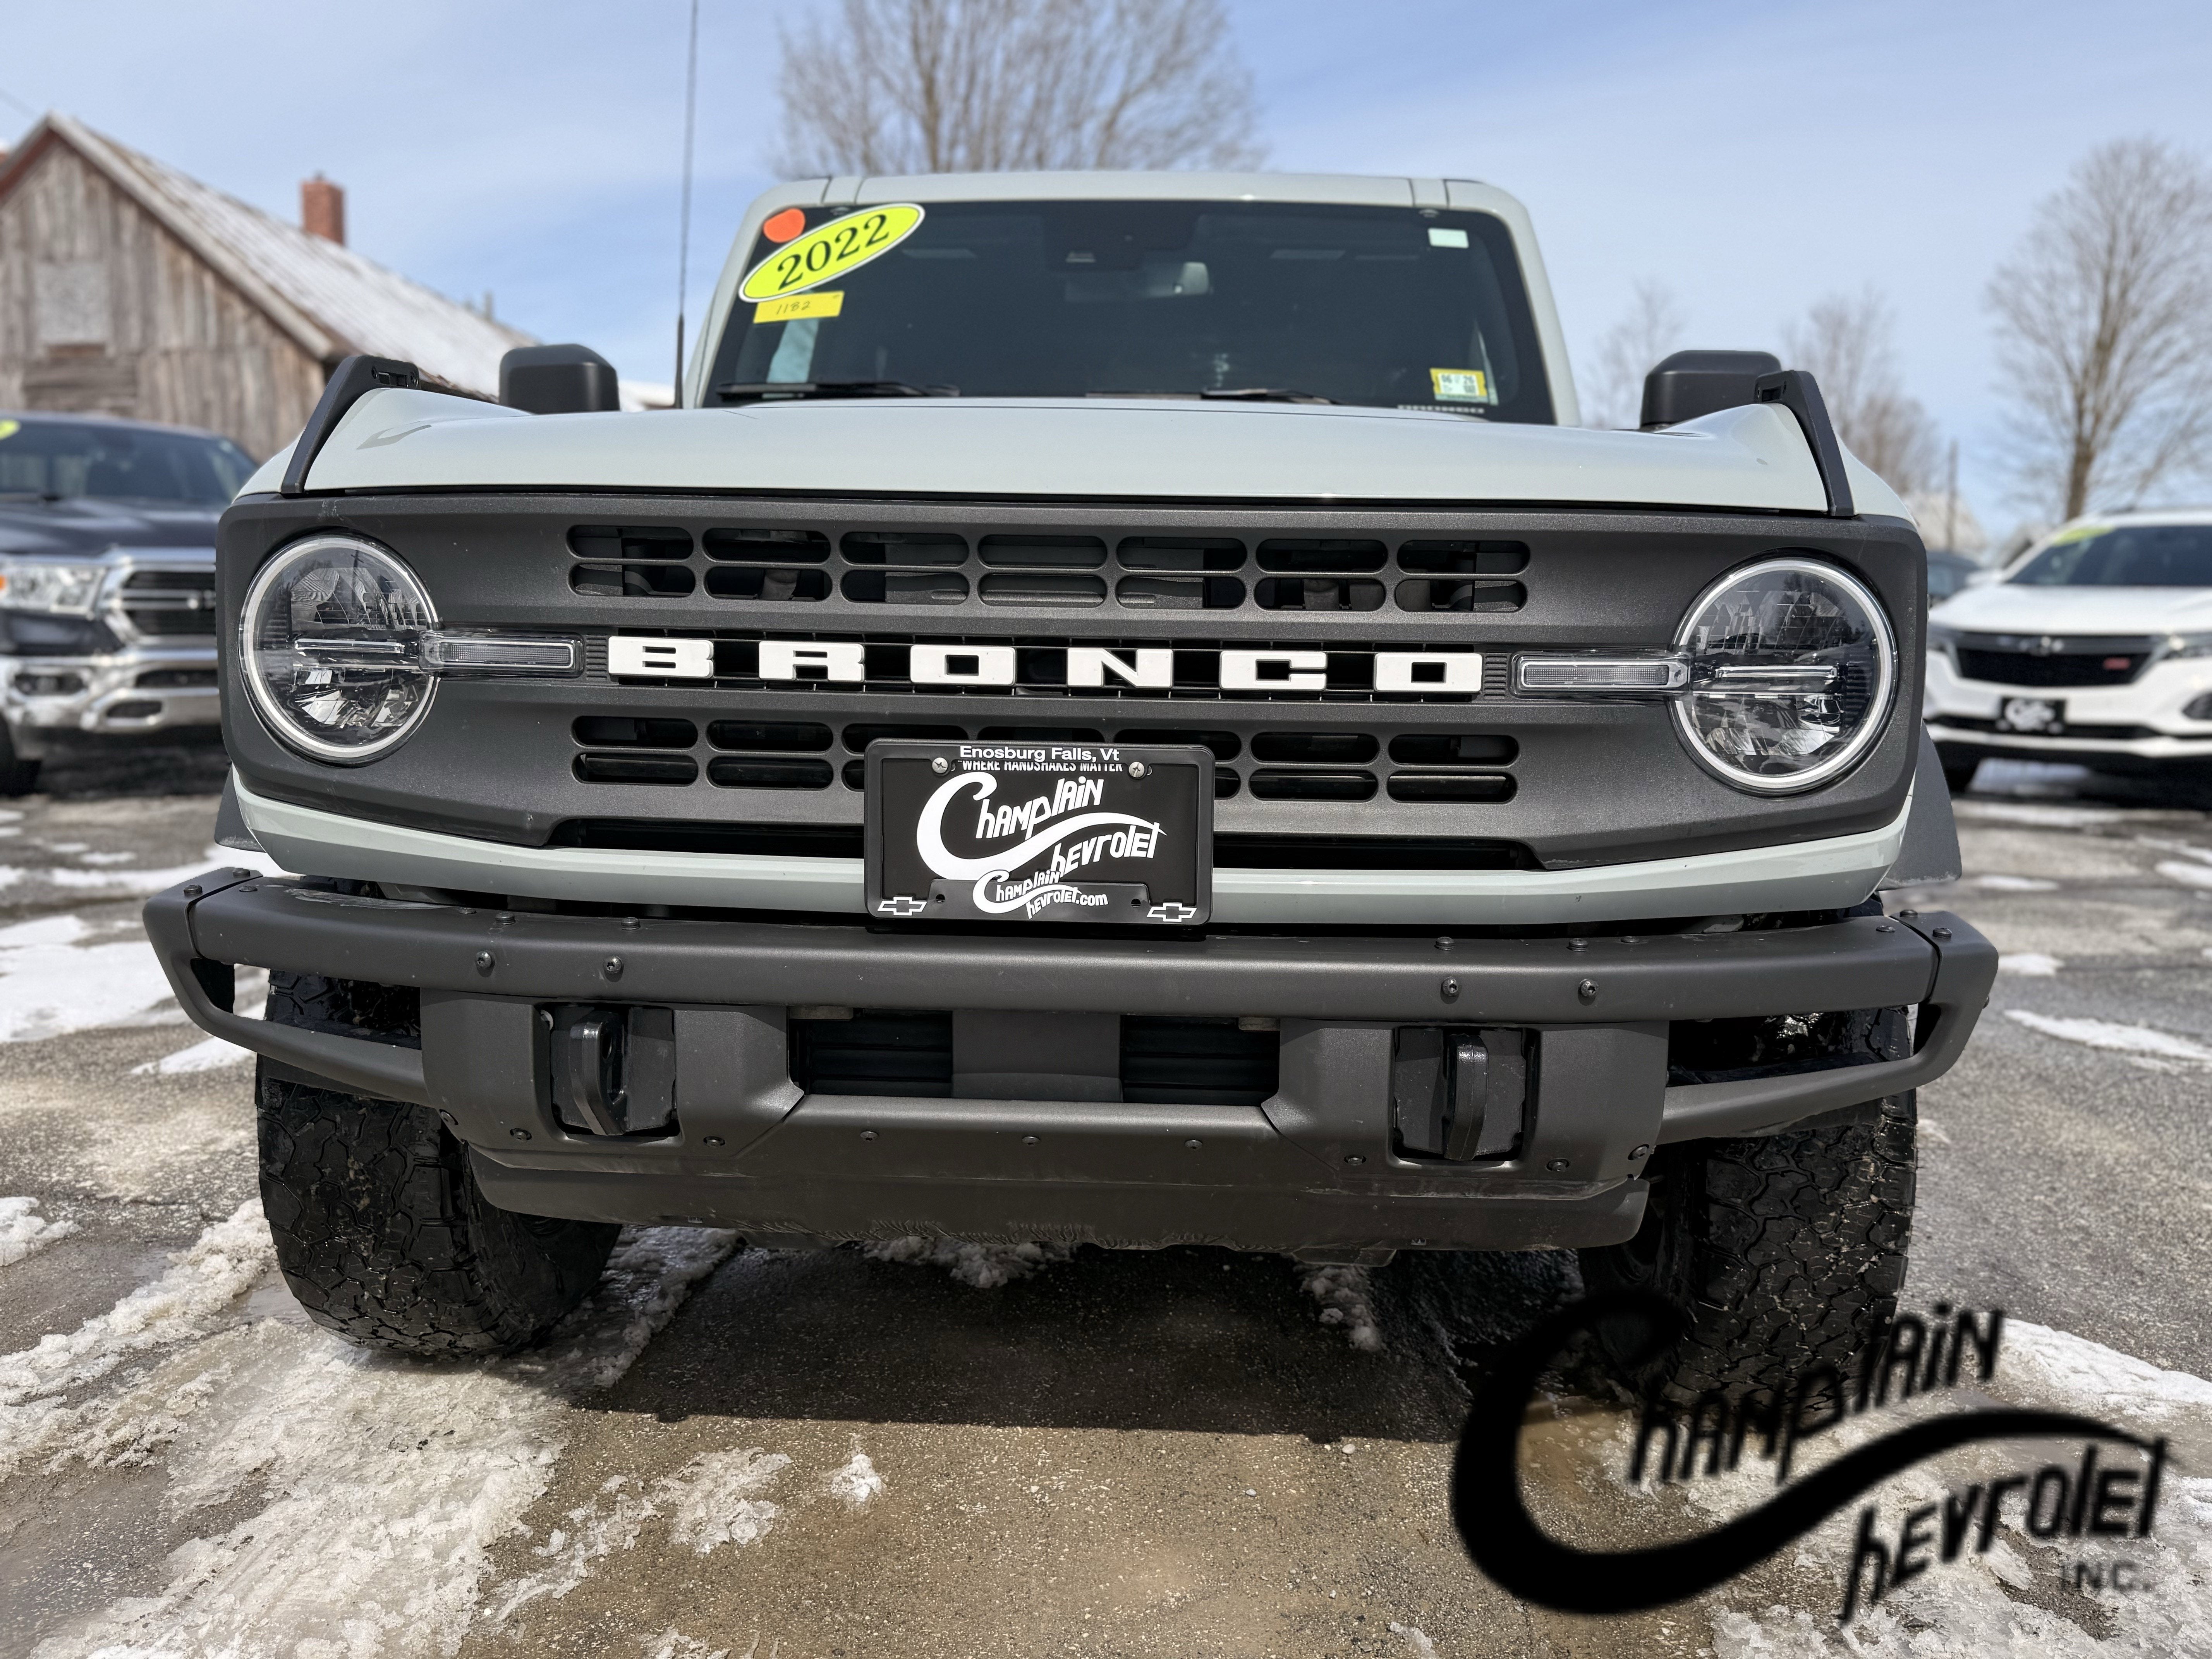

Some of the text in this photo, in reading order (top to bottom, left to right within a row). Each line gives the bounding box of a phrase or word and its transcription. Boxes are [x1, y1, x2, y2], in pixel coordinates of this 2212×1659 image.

[777, 214, 890, 291] 2022
[608, 635, 1483, 693] BRONCO
[960, 745, 1120, 763] Enosburg Falls, Vt
